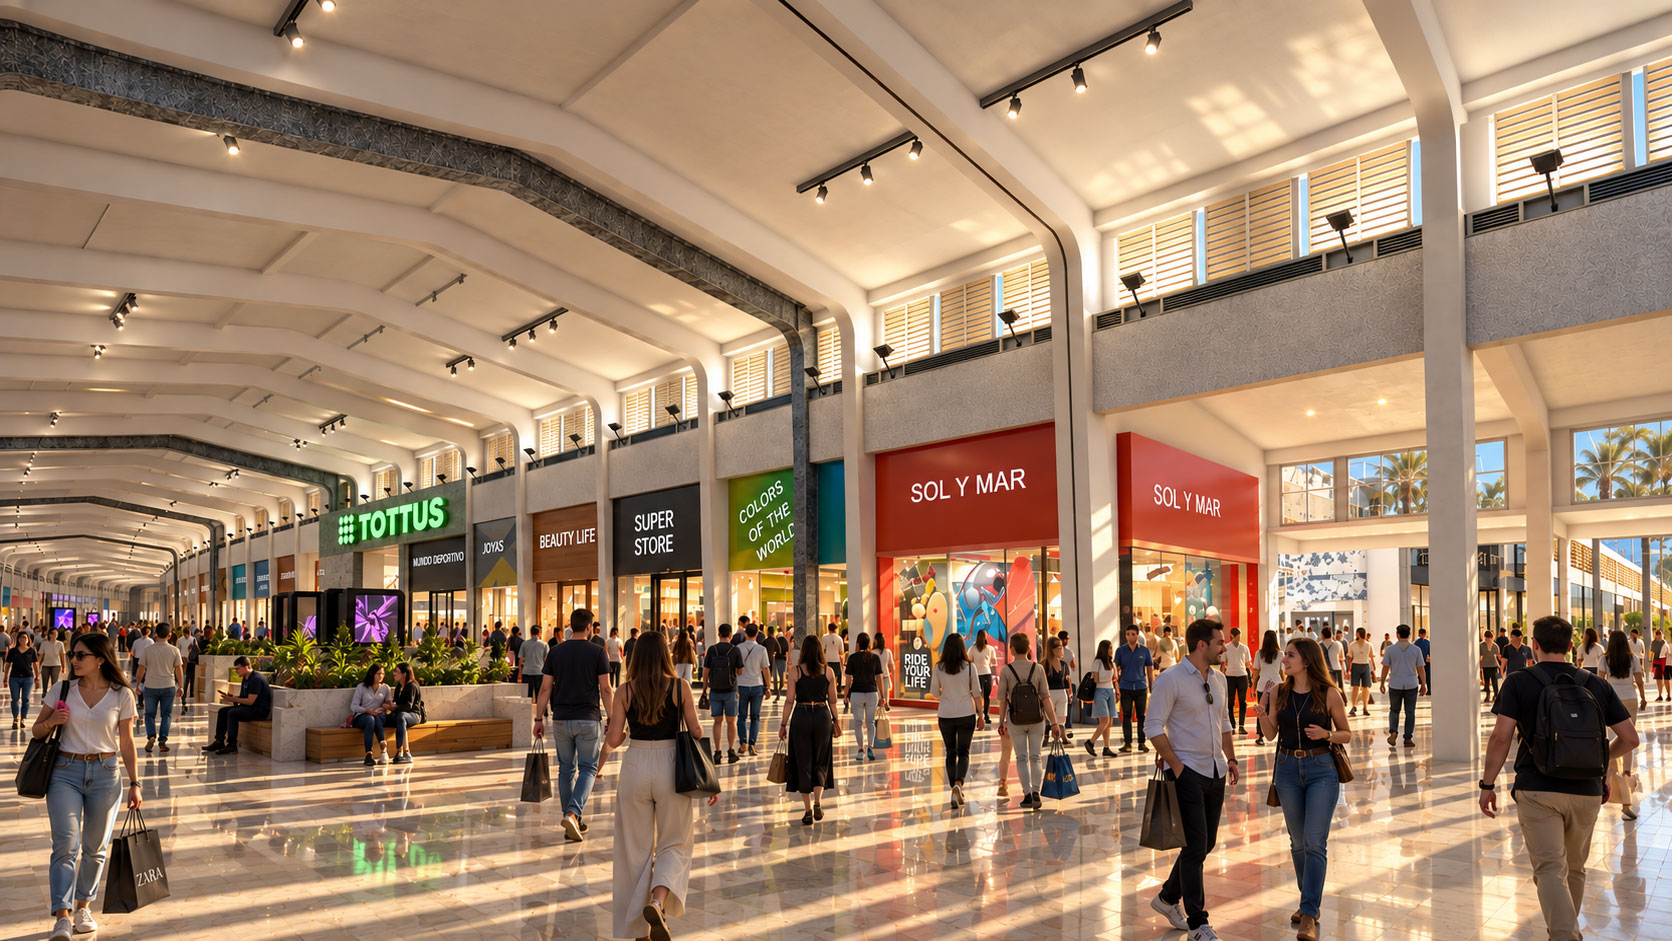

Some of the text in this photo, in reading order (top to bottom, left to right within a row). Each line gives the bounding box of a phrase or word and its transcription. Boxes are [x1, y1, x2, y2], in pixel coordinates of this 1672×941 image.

[911, 468, 1026, 503] SOL Y MAR
[739, 480, 784, 524] COLORS
[1153, 484, 1221, 518] SOL Y MAR
[358, 496, 447, 541] TOTTUS
[634, 509, 674, 533] SUPER
[748, 502, 791, 542] OF THE
[482, 539, 504, 555] JOYAS
[539, 527, 596, 549] BEAUTY LIFE
[634, 534, 674, 556] STORE
[904, 653, 928, 666] RIDE
[904, 665, 931, 677] YOUR
[904, 676, 927, 689] LIFE
[136, 866, 163, 887] ZARA
